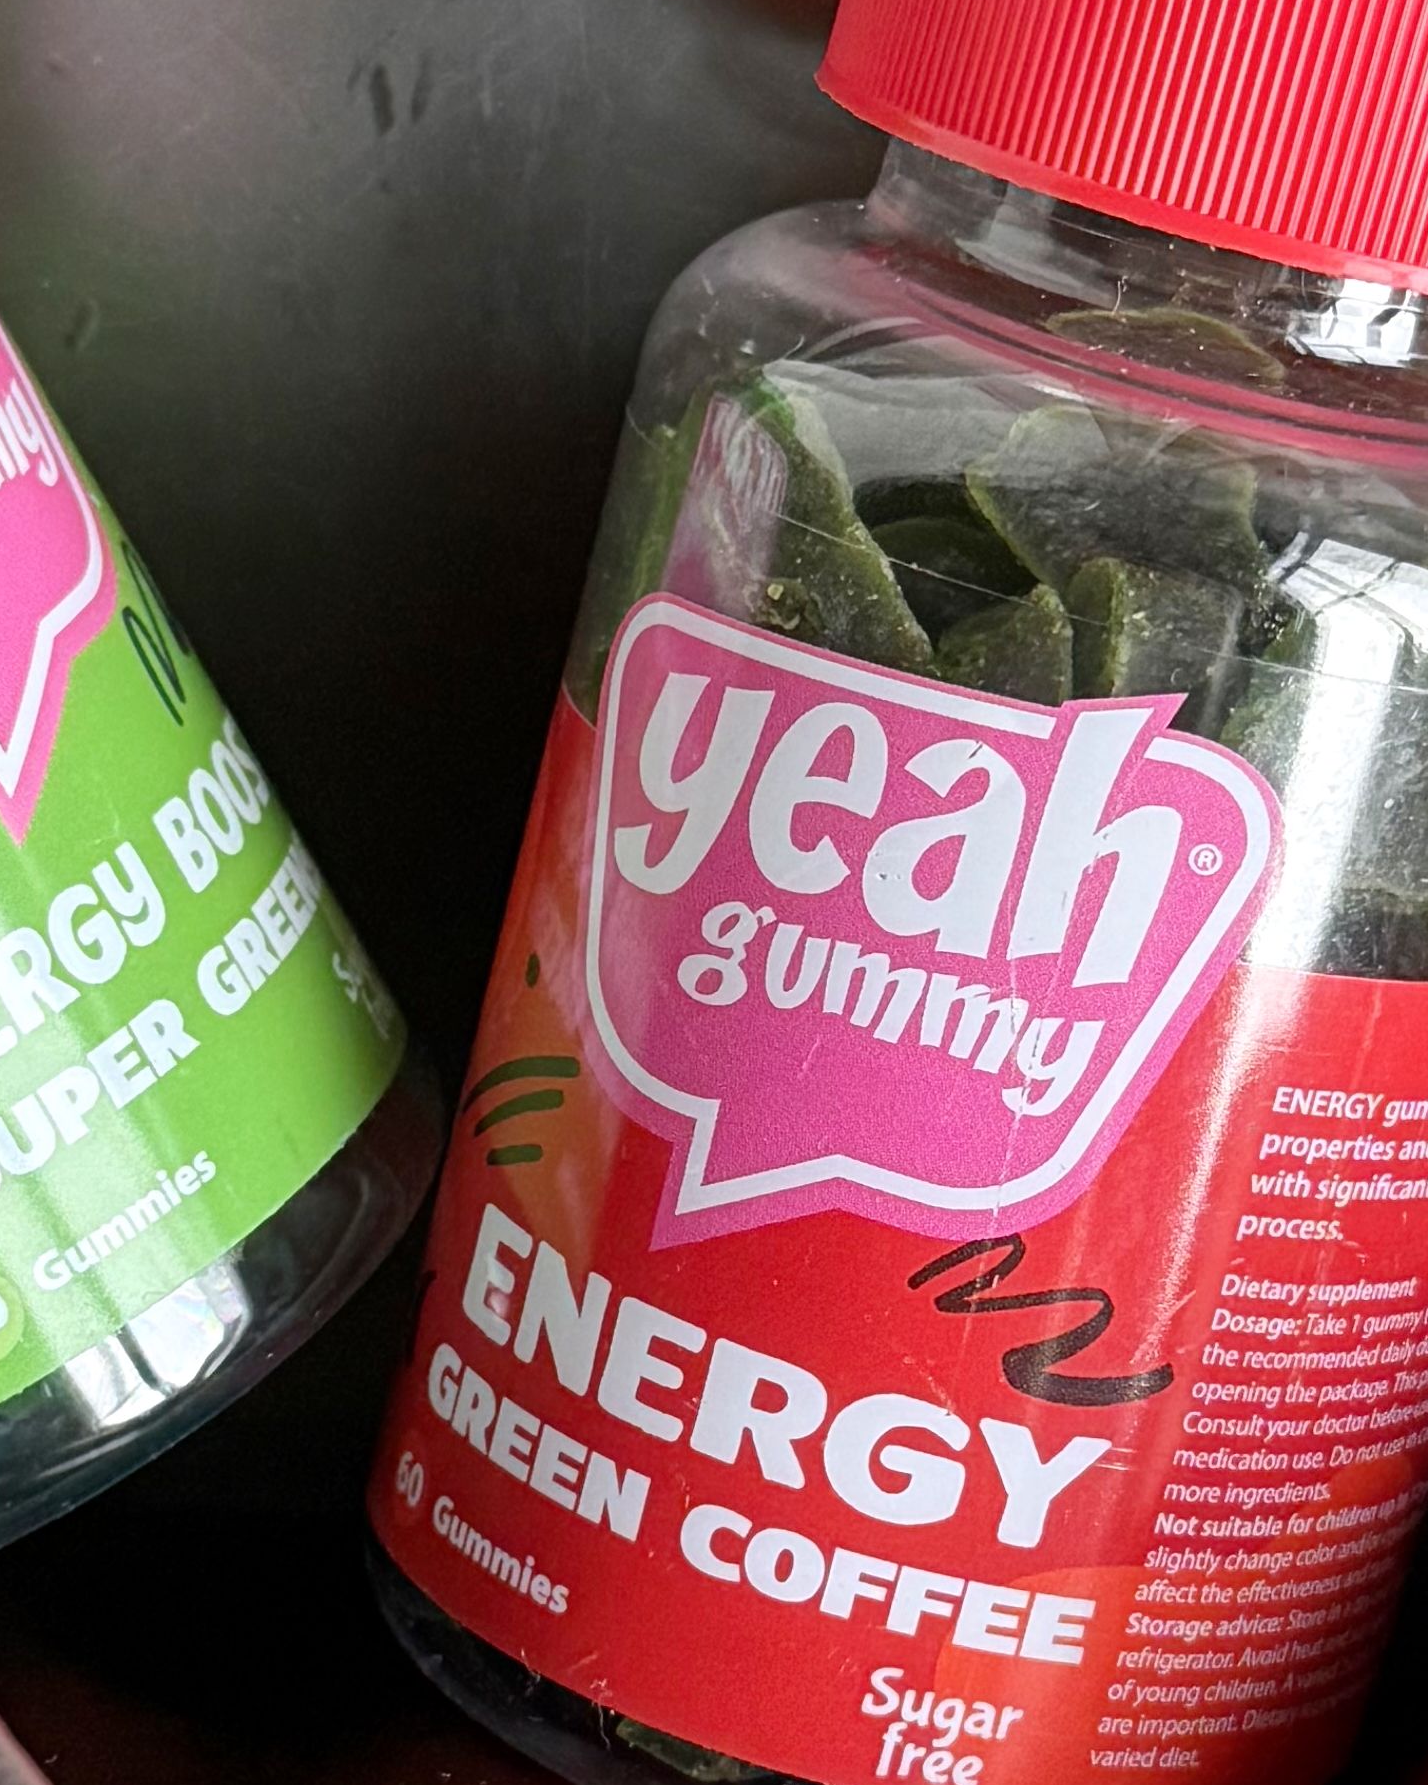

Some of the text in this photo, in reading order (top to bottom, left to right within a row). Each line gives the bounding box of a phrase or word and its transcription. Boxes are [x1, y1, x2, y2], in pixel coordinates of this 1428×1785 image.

[153, 710, 271, 894] BOOS
[614, 672, 1183, 988] yeah
[677, 900, 1103, 1117] gummy
[1272, 1086, 1385, 1120] ENERGY
[1259, 1132, 1394, 1164] properties
[1250, 1170, 1311, 1198] with
[32, 1151, 217, 1291] Gummies
[1236, 1214, 1344, 1242] process.
[1221, 1273, 1418, 1307] Dietary supplement
[1211, 1308, 1301, 1340] Dosage:
[1305, 1313, 1347, 1336] Take
[1352, 1313, 1361, 1334] 1
[1361, 1310, 1425, 1339] gummy
[1202, 1343, 1238, 1367] the
[1242, 1343, 1381, 1370] recommended
[1381, 1338, 1416, 1365] daily
[462, 1203, 1112, 1549] ENERGY
[1191, 1380, 1279, 1409] opening
[1284, 1379, 1316, 1403] the
[1317, 1379, 1389, 1407] package.
[1182, 1411, 1262, 1435] Consult
[1260, 1420, 1310, 1444] your
[1312, 1413, 1370, 1435] doctor
[1173, 1447, 1288, 1471] medication
[1292, 1451, 1324, 1469] use.
[1329, 1444, 1354, 1467] Do
[1355, 1438, 1380, 1463] not
[427, 1342, 1096, 1665] GREEN COFFEE
[1164, 1480, 1331, 1510] more ingredients.
[1153, 1512, 1197, 1536] Not
[1201, 1512, 1282, 1537] suitable
[1286, 1512, 1315, 1535] for
[1315, 1505, 1378, 1532] children
[432, 1495, 569, 1614] Gummies
[1143, 1545, 1222, 1576] slightly
[1223, 1548, 1293, 1575] change
[1296, 1543, 1338, 1565] color
[1134, 1579, 1199, 1604] affect
[1200, 1582, 1233, 1605] the
[1125, 1612, 1214, 1642] Storage
[1215, 1613, 1284, 1638] advice:
[1116, 1646, 1233, 1676] refrigerator.
[1237, 1641, 1290, 1668] Avoid
[862, 1667, 1024, 1747] Sugar
[1107, 1679, 1134, 1702] of
[1133, 1686, 1199, 1709] young
[1203, 1677, 1277, 1702] children.
[1098, 1716, 1133, 1735] are
[1137, 1713, 1236, 1740] important.
[1090, 1747, 1155, 1768] varied
